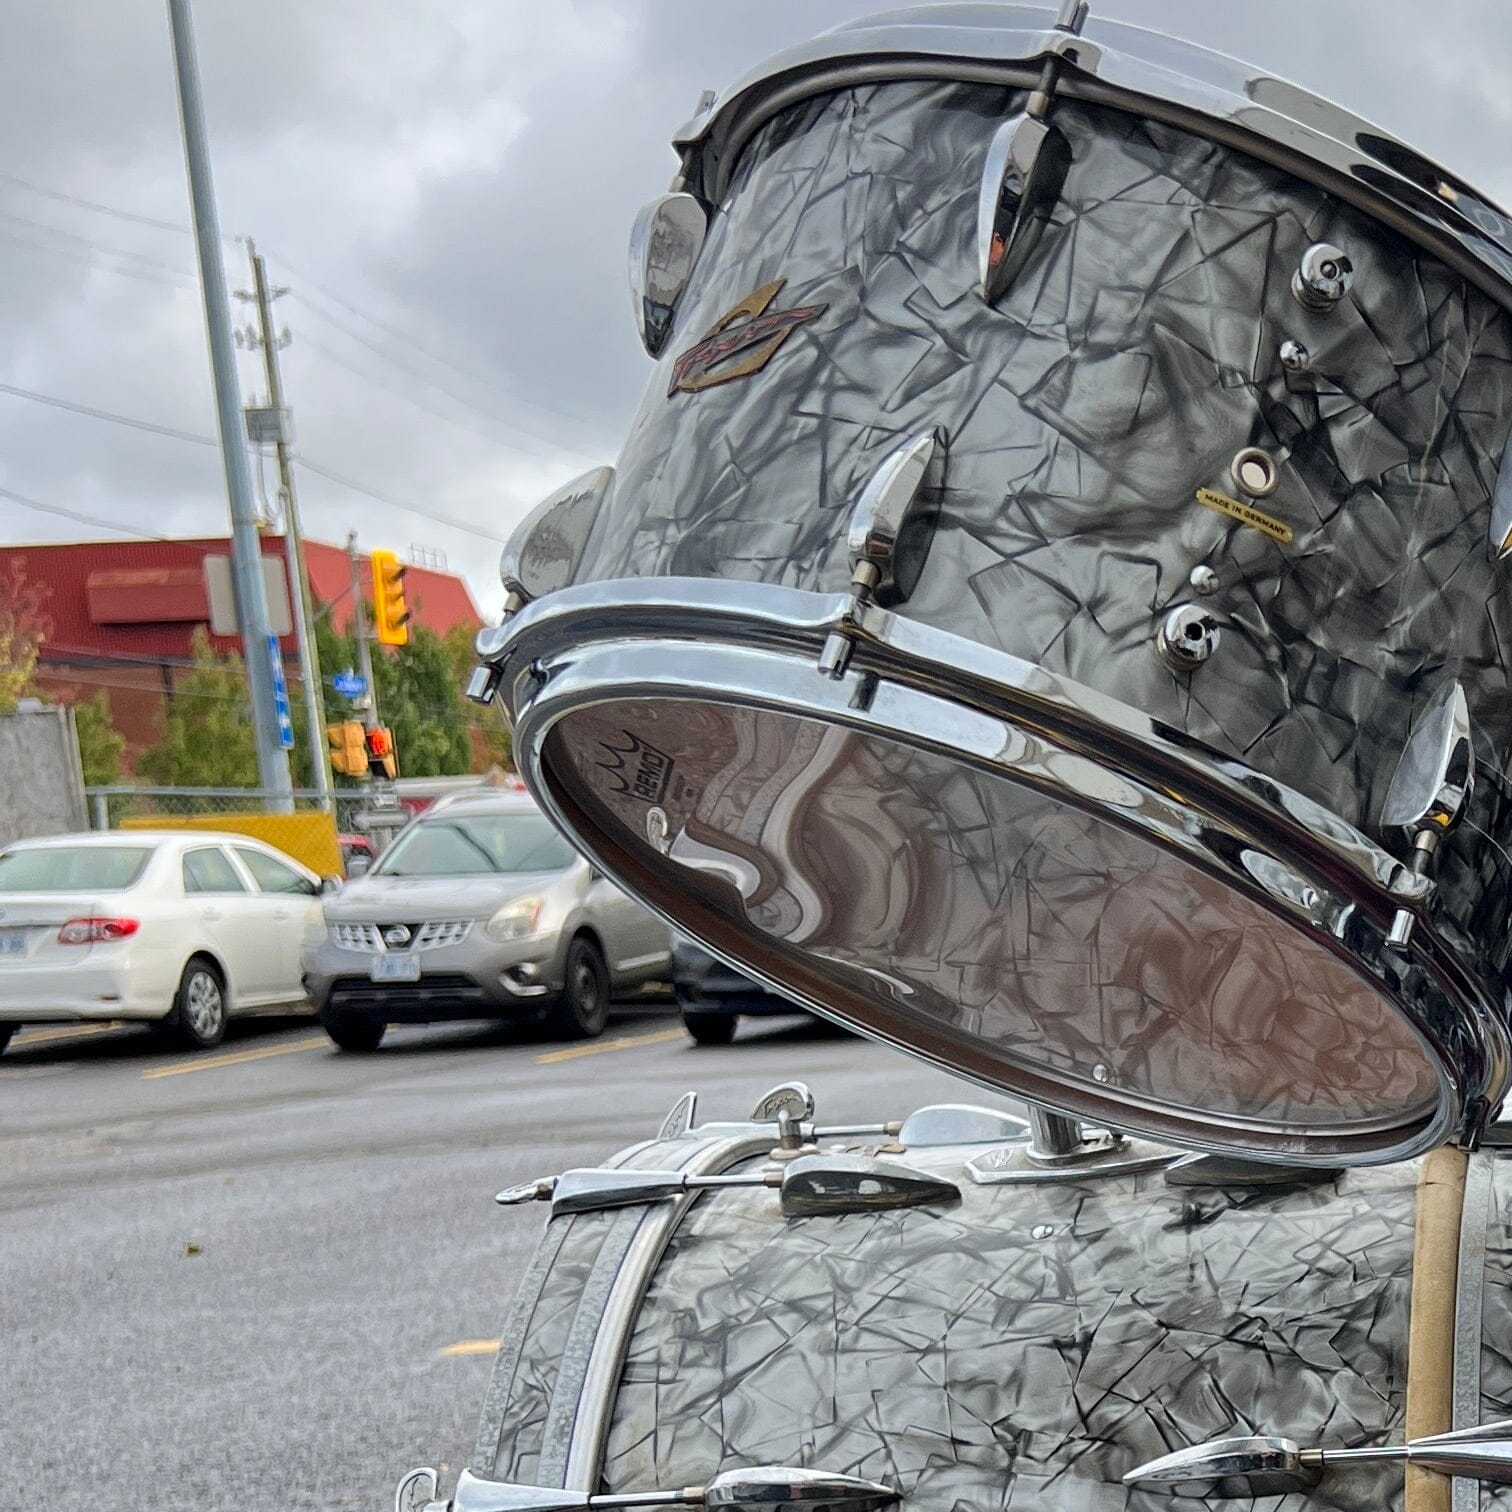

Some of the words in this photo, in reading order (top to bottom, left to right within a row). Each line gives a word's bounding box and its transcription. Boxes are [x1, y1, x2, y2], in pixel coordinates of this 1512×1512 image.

[1205, 494, 1229, 509] MADE
[1232, 505, 1242, 515] IN
[633, 751, 664, 799] REMO
